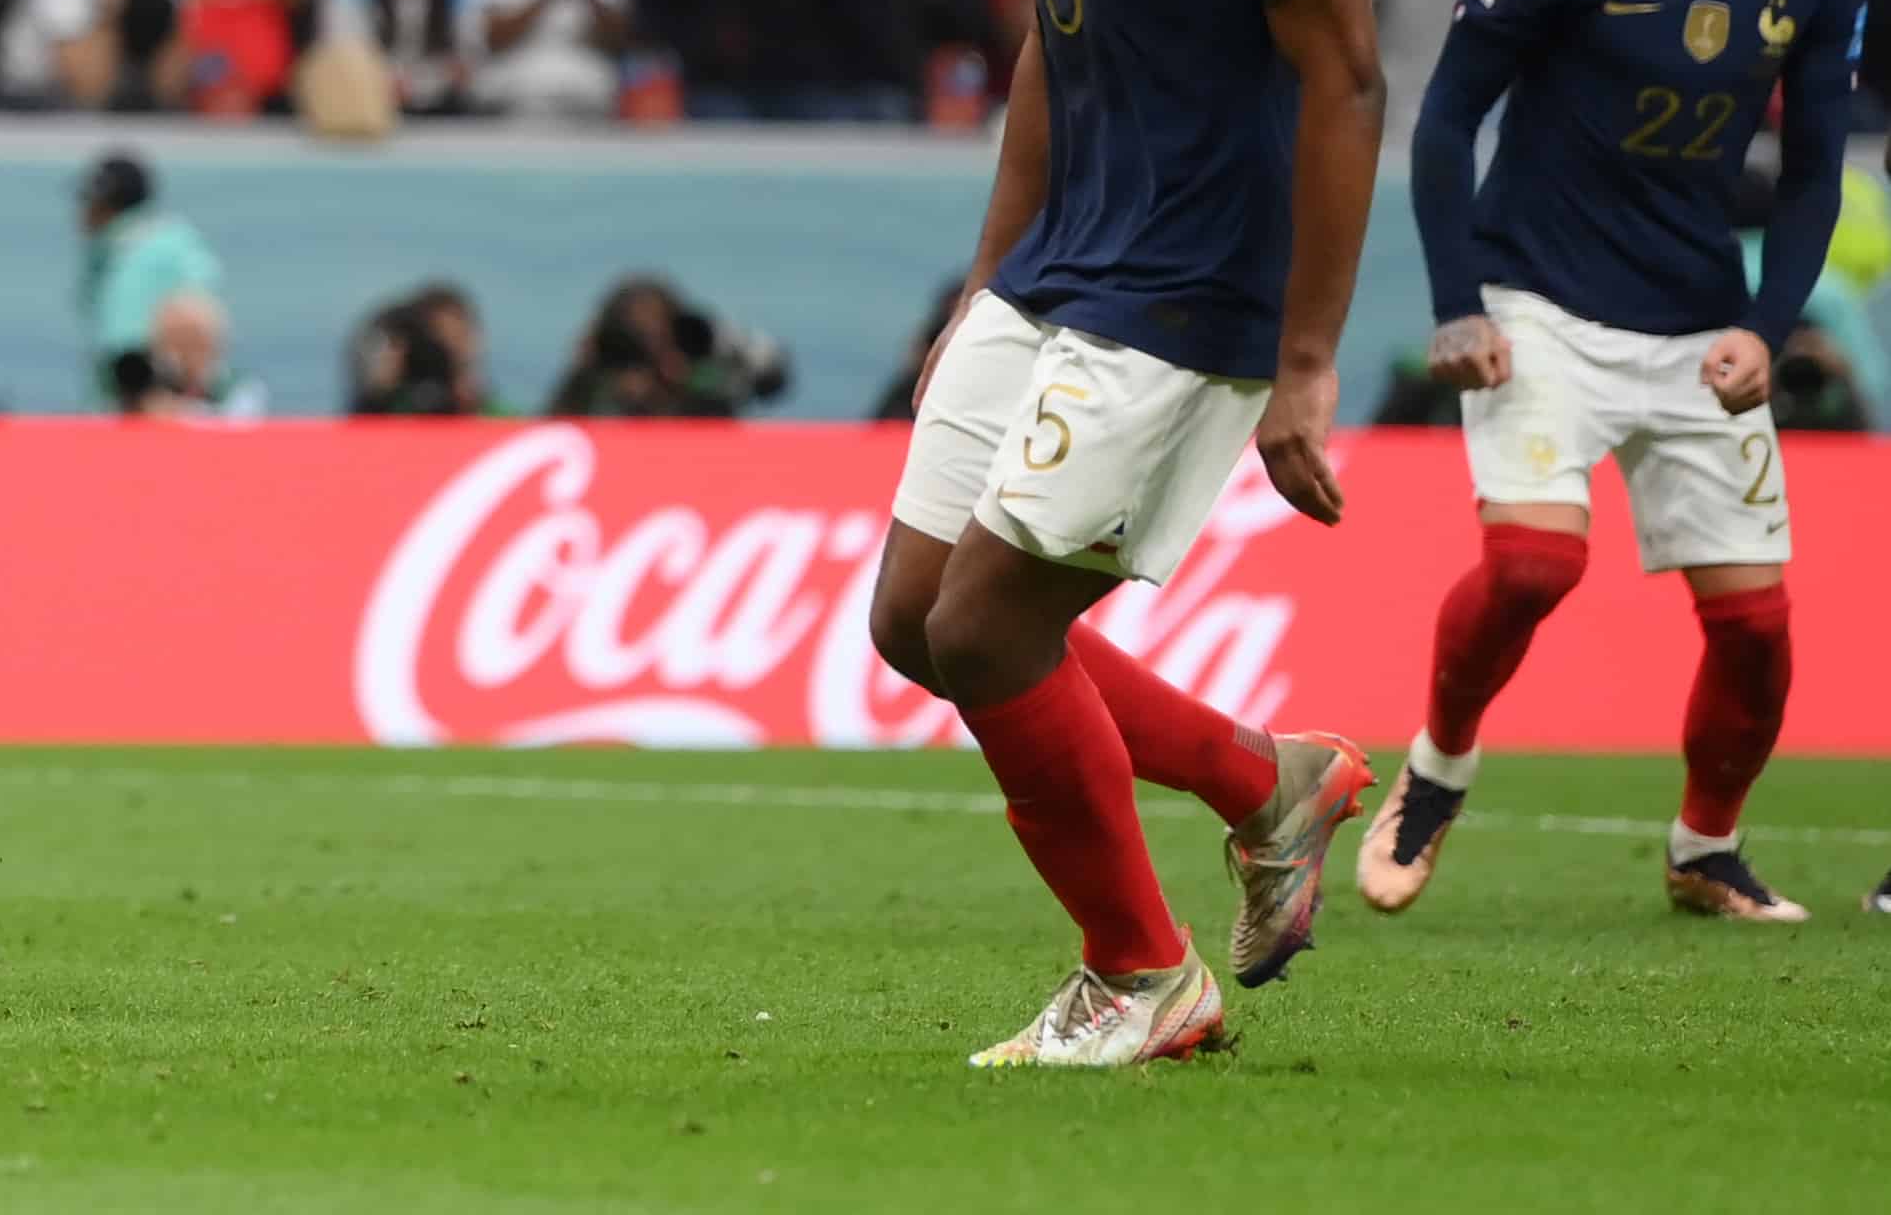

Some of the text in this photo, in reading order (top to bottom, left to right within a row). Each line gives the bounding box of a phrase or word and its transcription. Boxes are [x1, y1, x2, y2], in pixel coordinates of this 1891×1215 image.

[1619, 87, 1737, 161] 22
[1023, 383, 1089, 472] 5
[1740, 432, 1778, 505] 2
